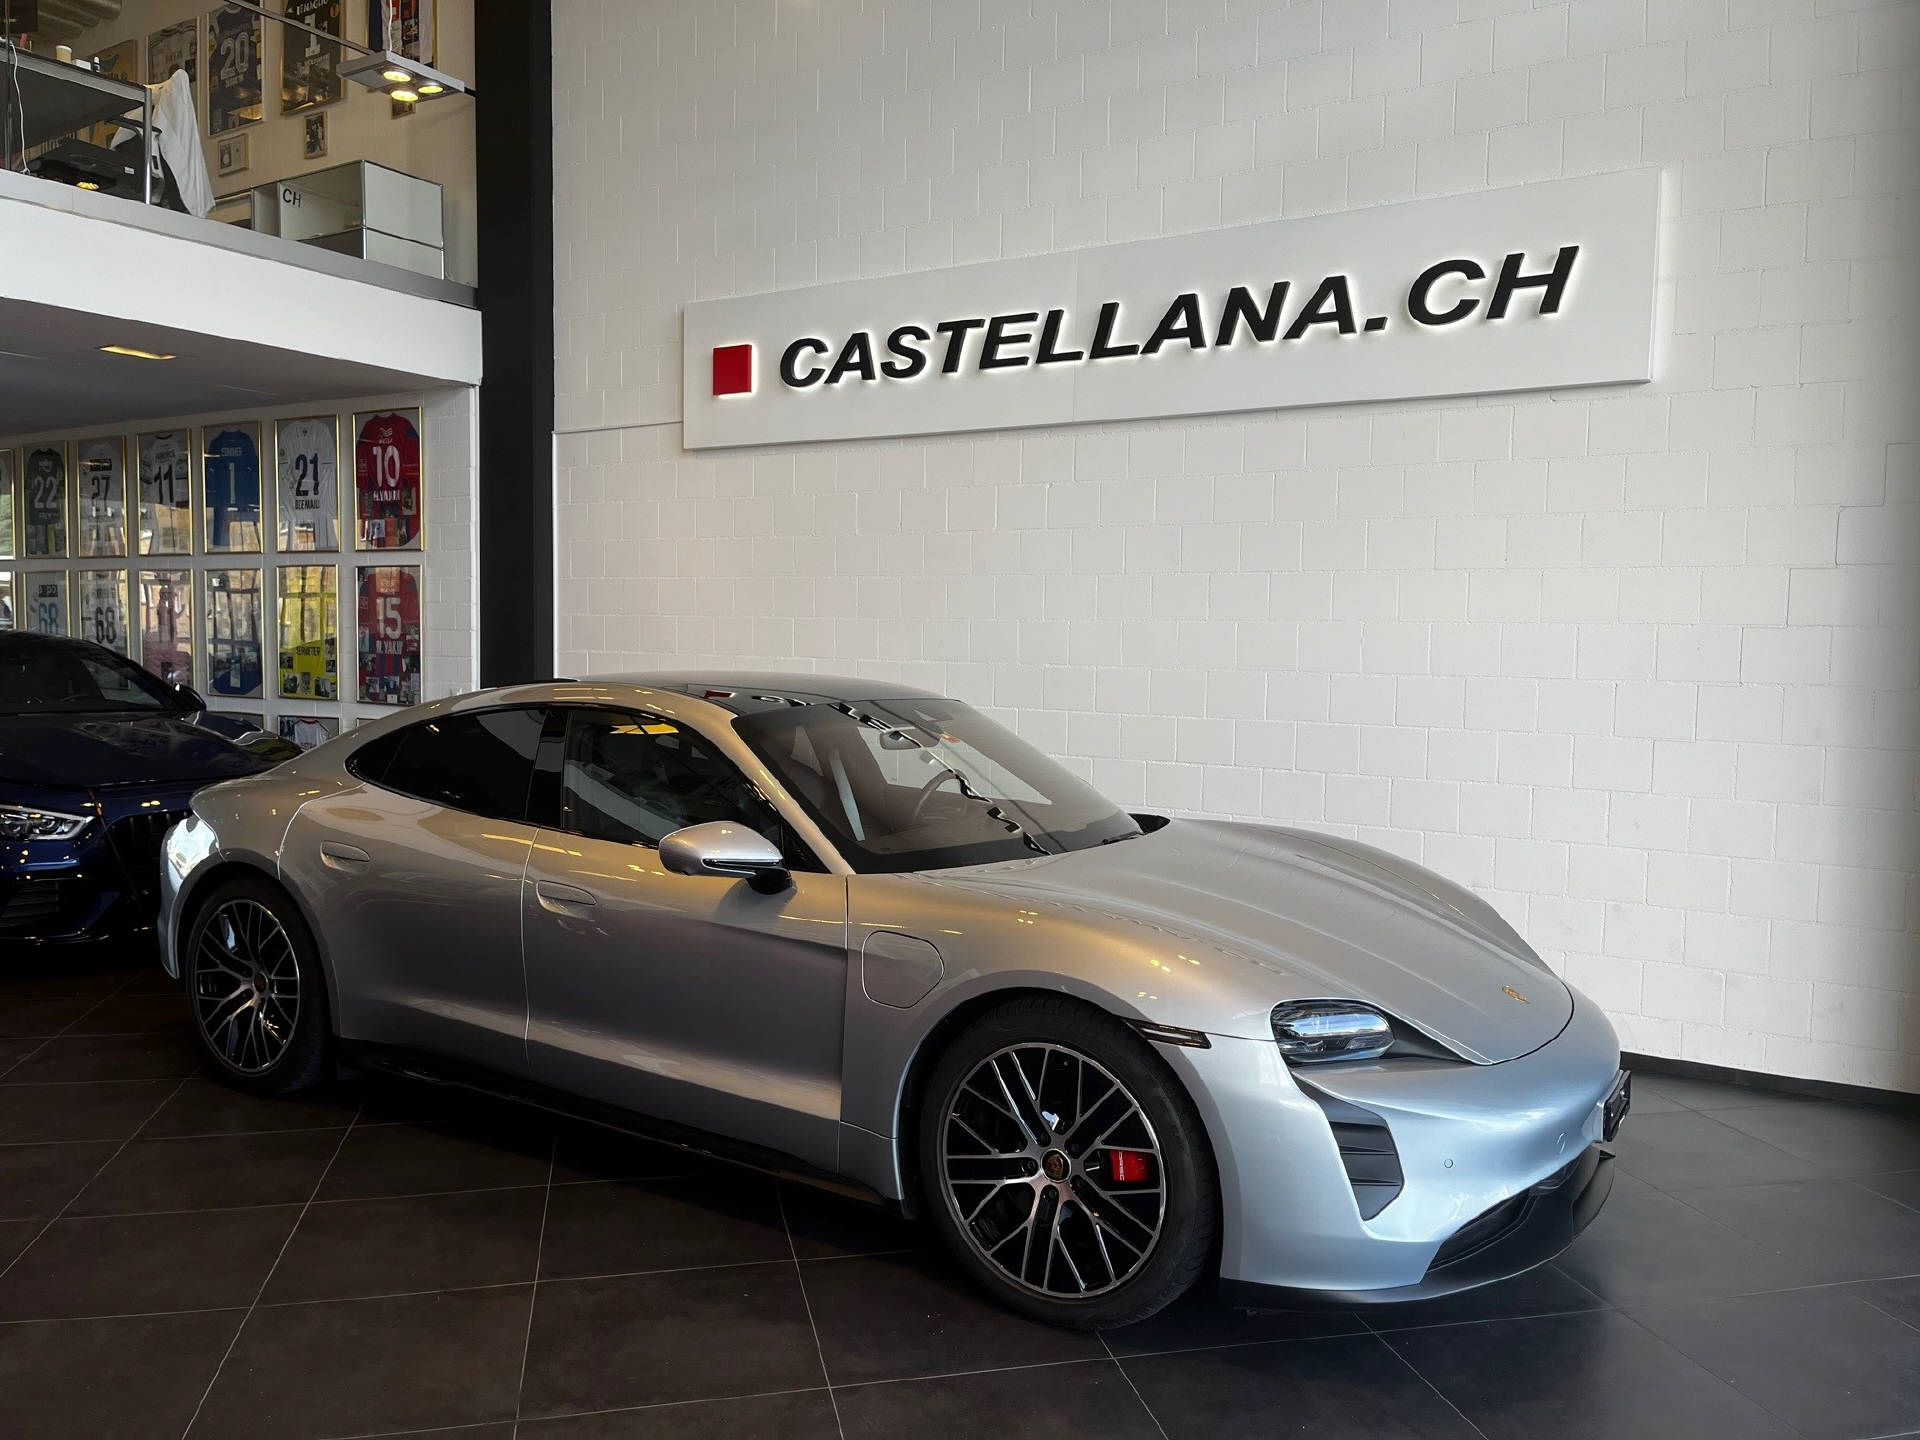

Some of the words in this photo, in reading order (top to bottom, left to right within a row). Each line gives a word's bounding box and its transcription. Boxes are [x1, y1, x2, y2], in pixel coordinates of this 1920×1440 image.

[220, 31, 250, 81] 20
[305, 13, 321, 58] 1
[282, 188, 302, 208] CH
[779, 245, 1580, 388] CASTELLANA.CH
[154, 464, 174, 505] 11
[228, 462, 236, 505] 1
[295, 453, 320, 497] 21
[372, 445, 400, 488] 10
[34, 476, 58, 509] 22
[91, 475, 111, 512] 27
[95, 606, 117, 644] 68
[376, 597, 402, 640] 15
